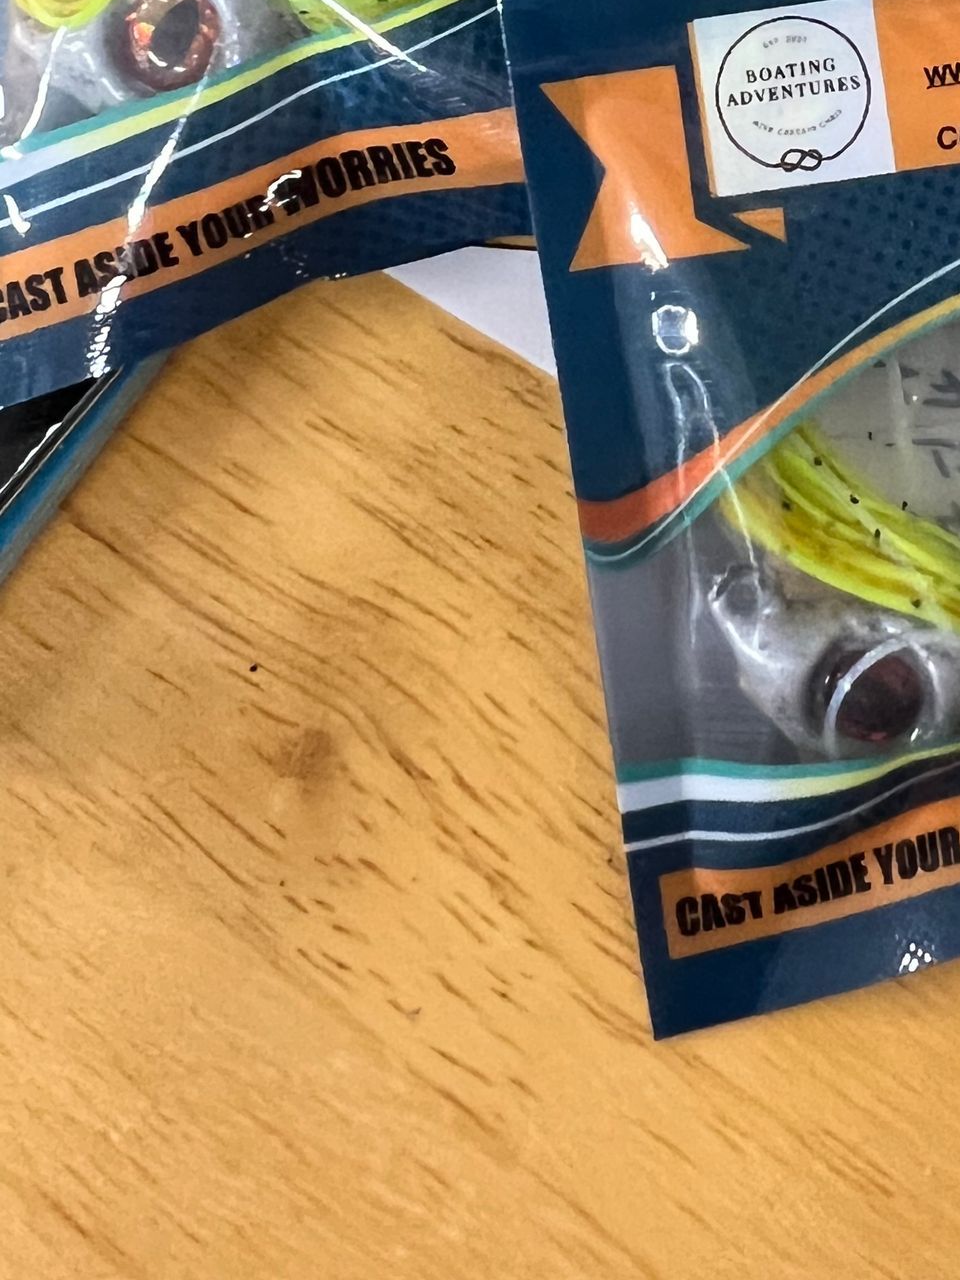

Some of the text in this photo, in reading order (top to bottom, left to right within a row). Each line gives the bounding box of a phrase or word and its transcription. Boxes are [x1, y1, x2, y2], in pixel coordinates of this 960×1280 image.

[727, 75, 861, 107] ADVENTURES
[746, 57, 836, 84] BOATING
[74, 232, 180, 297] ASIDE
[176, 194, 275, 257] YOUR
[267, 138, 457, 216] WORRIES
[675, 889, 763, 937] CAST
[773, 852, 871, 915] ASIDE
